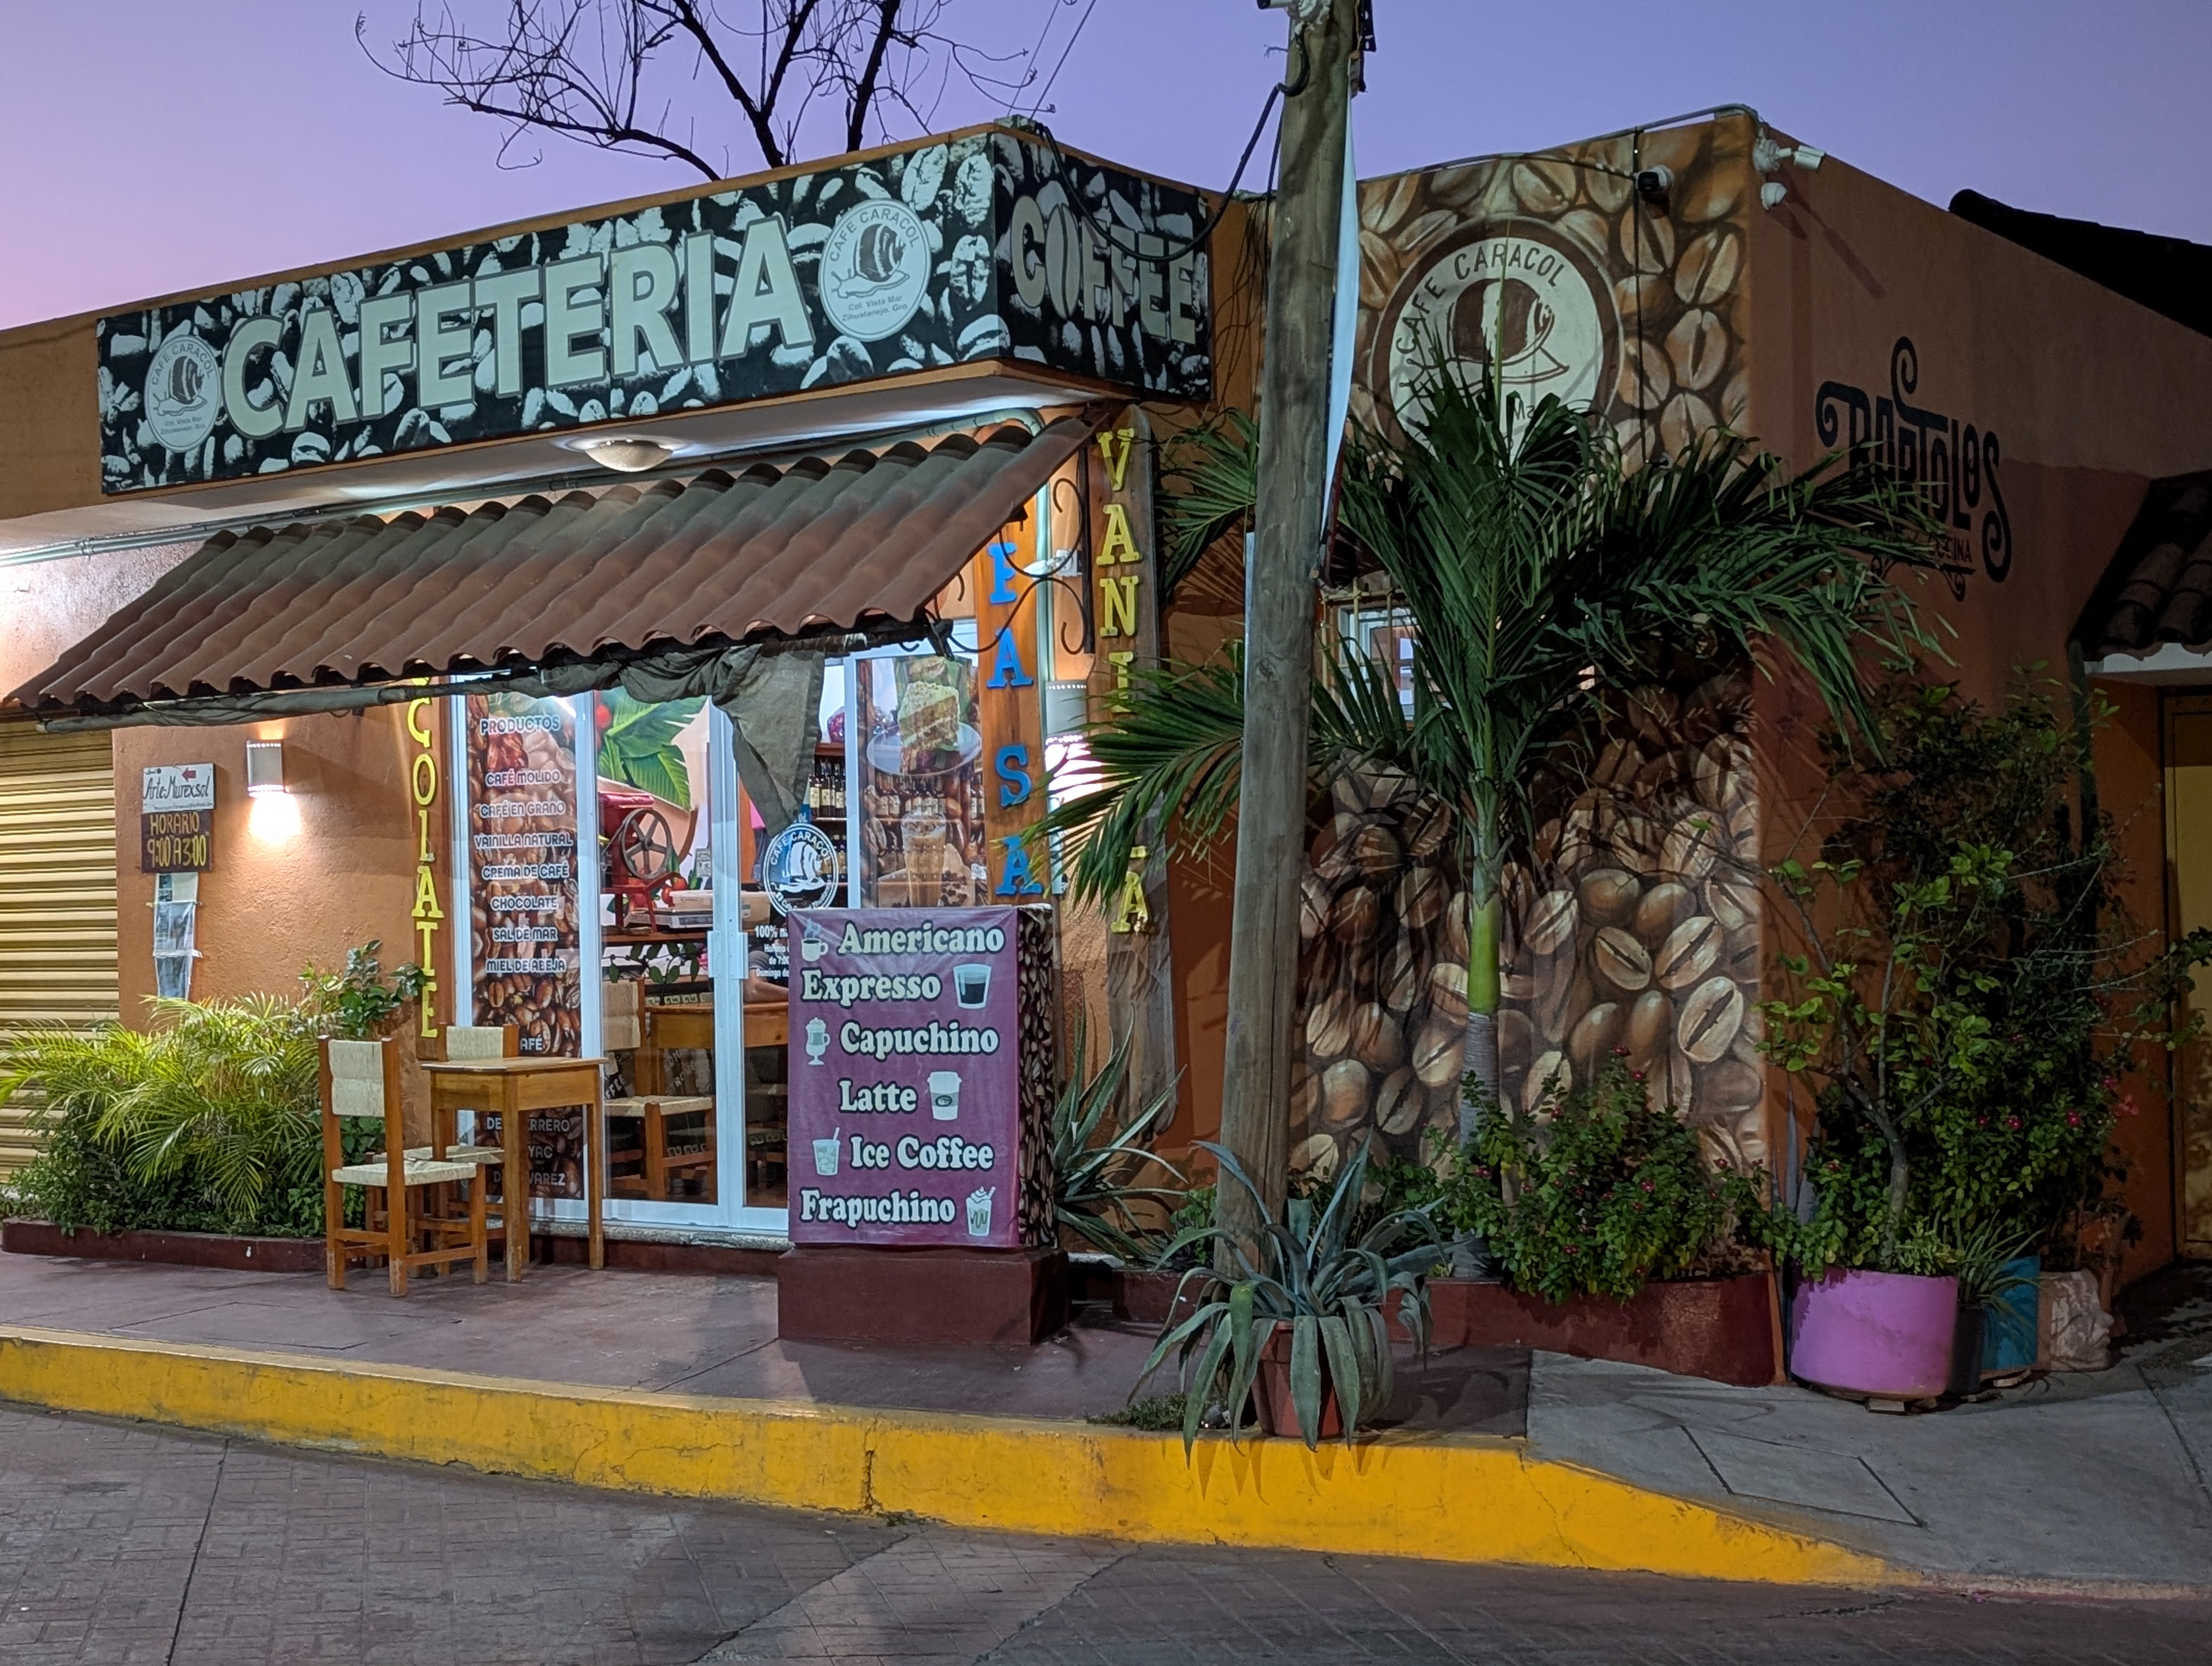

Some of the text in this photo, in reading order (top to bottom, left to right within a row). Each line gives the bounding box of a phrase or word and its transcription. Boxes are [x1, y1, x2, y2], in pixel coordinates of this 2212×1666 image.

[829, 208, 921, 261] CAFE CARACOL
[1396, 244, 1565, 355] CAFE CARACOL
[222, 212, 816, 440] CAFETERIA
[171, 343, 214, 379] CARACOL
[480, 715, 560, 735] PRODUCTOS
[487, 769, 561, 787] CAFÉ MOLIDO
[481, 800, 566, 818] CAFÉ EN GRANO
[149, 812, 200, 836] HORARIO
[172, 837, 182, 866] A
[474, 832, 573, 849] VAINILLA NATURAL
[770, 830, 831, 866] CAFE CARACOL
[483, 861, 569, 880] CREMA DE CAFÉ
[491, 896, 558, 911] CHOCOLATE
[493, 927, 558, 941] SAL DE MAR
[754, 925, 778, 938] 100%
[837, 921, 1006, 954] Americano
[486, 958, 565, 973] MIEL DE ABEJA
[801, 969, 941, 1006] Expresso
[519, 1034, 543, 1051] AFÉ
[839, 1021, 999, 1059] Capuchino
[839, 1080, 917, 1112] Latte
[528, 1118, 570, 1132] RRERO
[850, 1136, 994, 1169] Ice Coffee
[800, 1189, 955, 1227] Frapuchino
